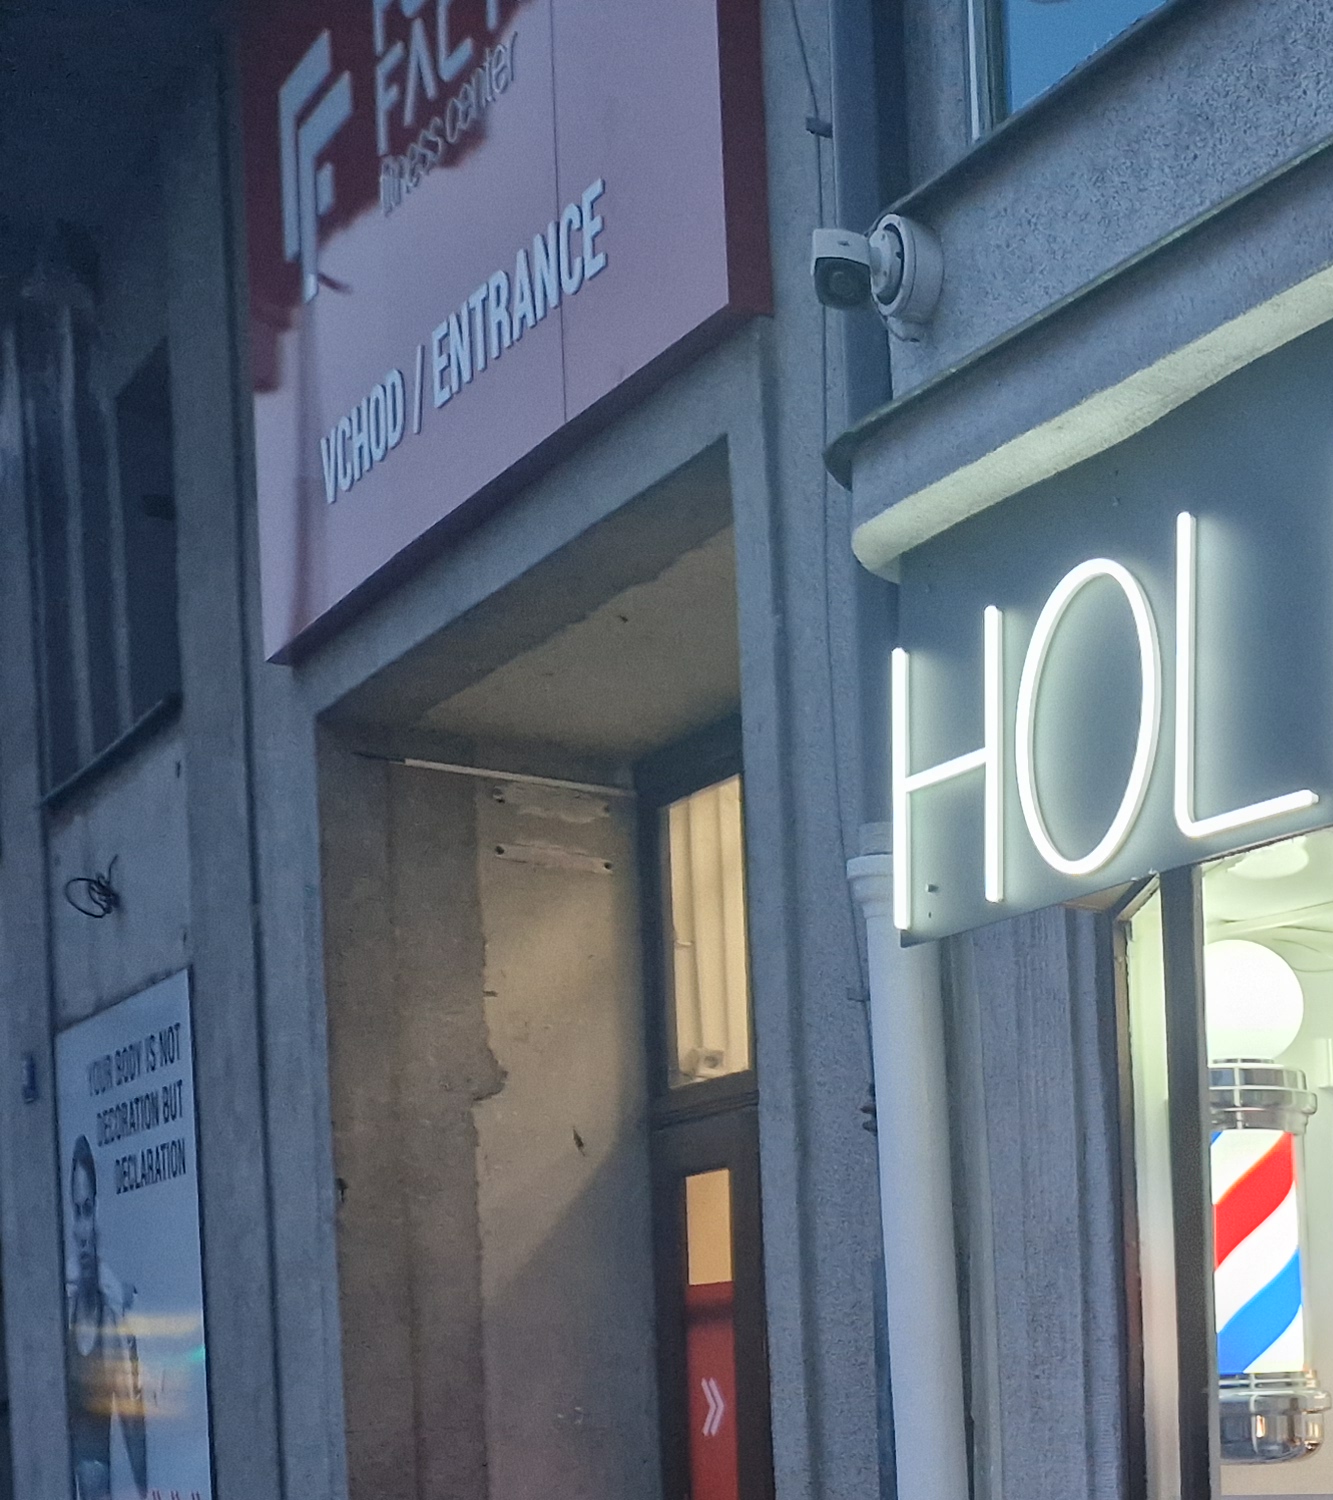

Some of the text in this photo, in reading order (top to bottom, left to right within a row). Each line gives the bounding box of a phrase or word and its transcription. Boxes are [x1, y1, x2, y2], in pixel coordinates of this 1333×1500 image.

[319, 366, 407, 504] VCHOD
[430, 178, 608, 410] ENTRANCE
[115, 1040, 142, 1086] BODY
[145, 1034, 156, 1073] IS
[158, 1022, 181, 1067] NOT
[97, 1079, 184, 1147] DECORATION BUT
[115, 1137, 187, 1195] DECLARATION
